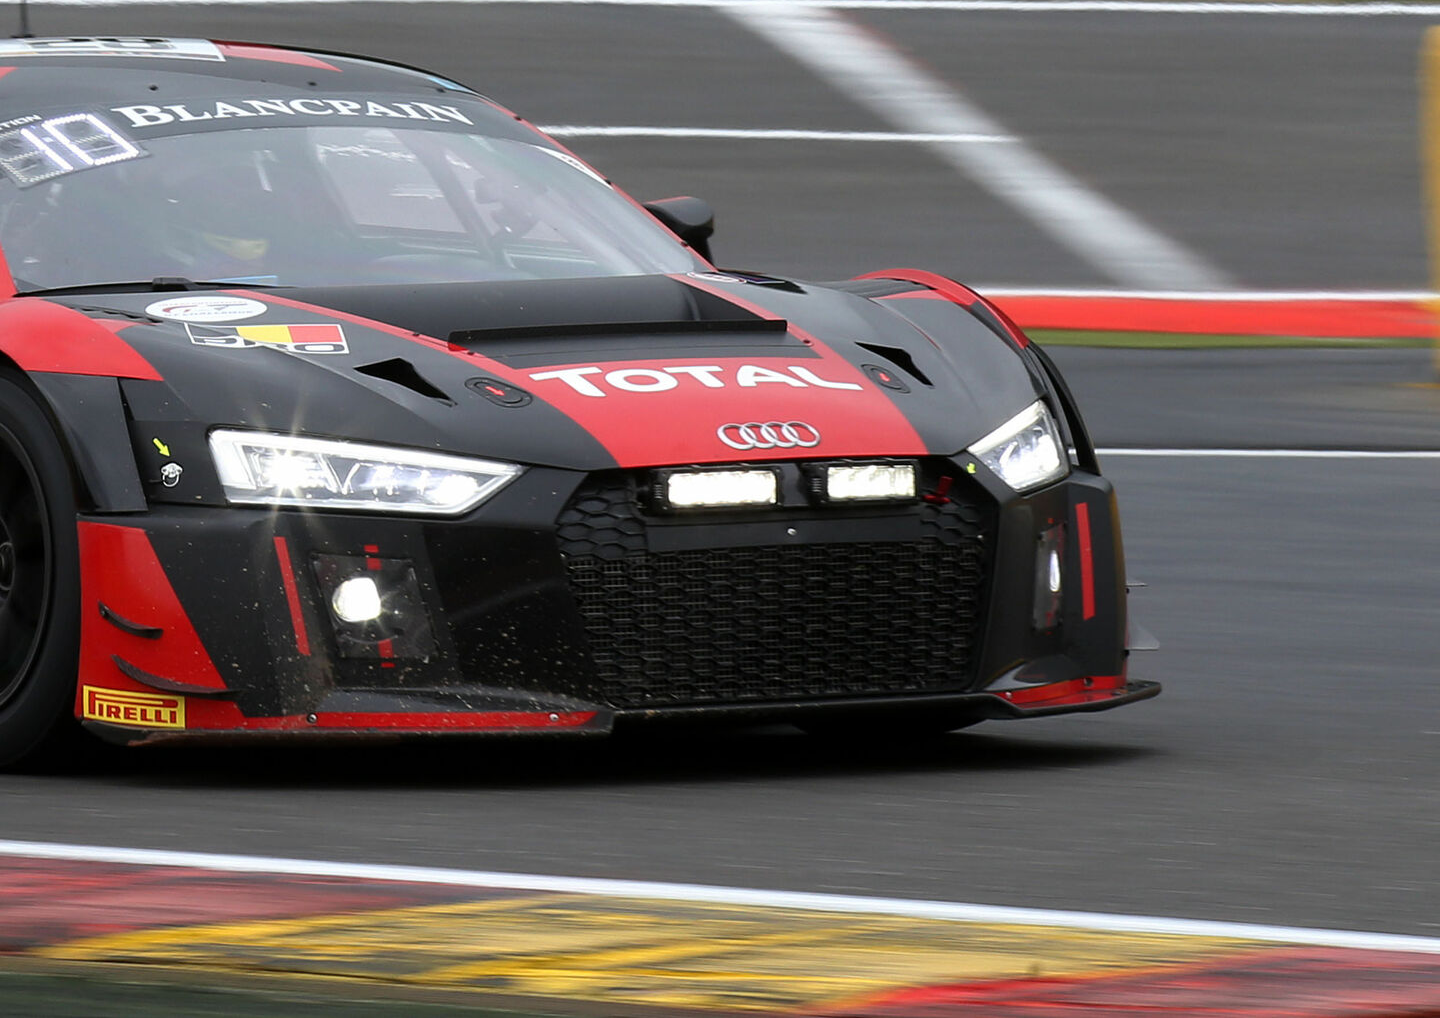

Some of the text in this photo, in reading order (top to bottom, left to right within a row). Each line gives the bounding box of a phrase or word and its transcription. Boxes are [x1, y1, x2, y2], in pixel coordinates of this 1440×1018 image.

[110, 99, 474, 128] BLANCPAIN
[528, 365, 864, 398] TOTAL
[87, 689, 179, 724] PIRELLI
